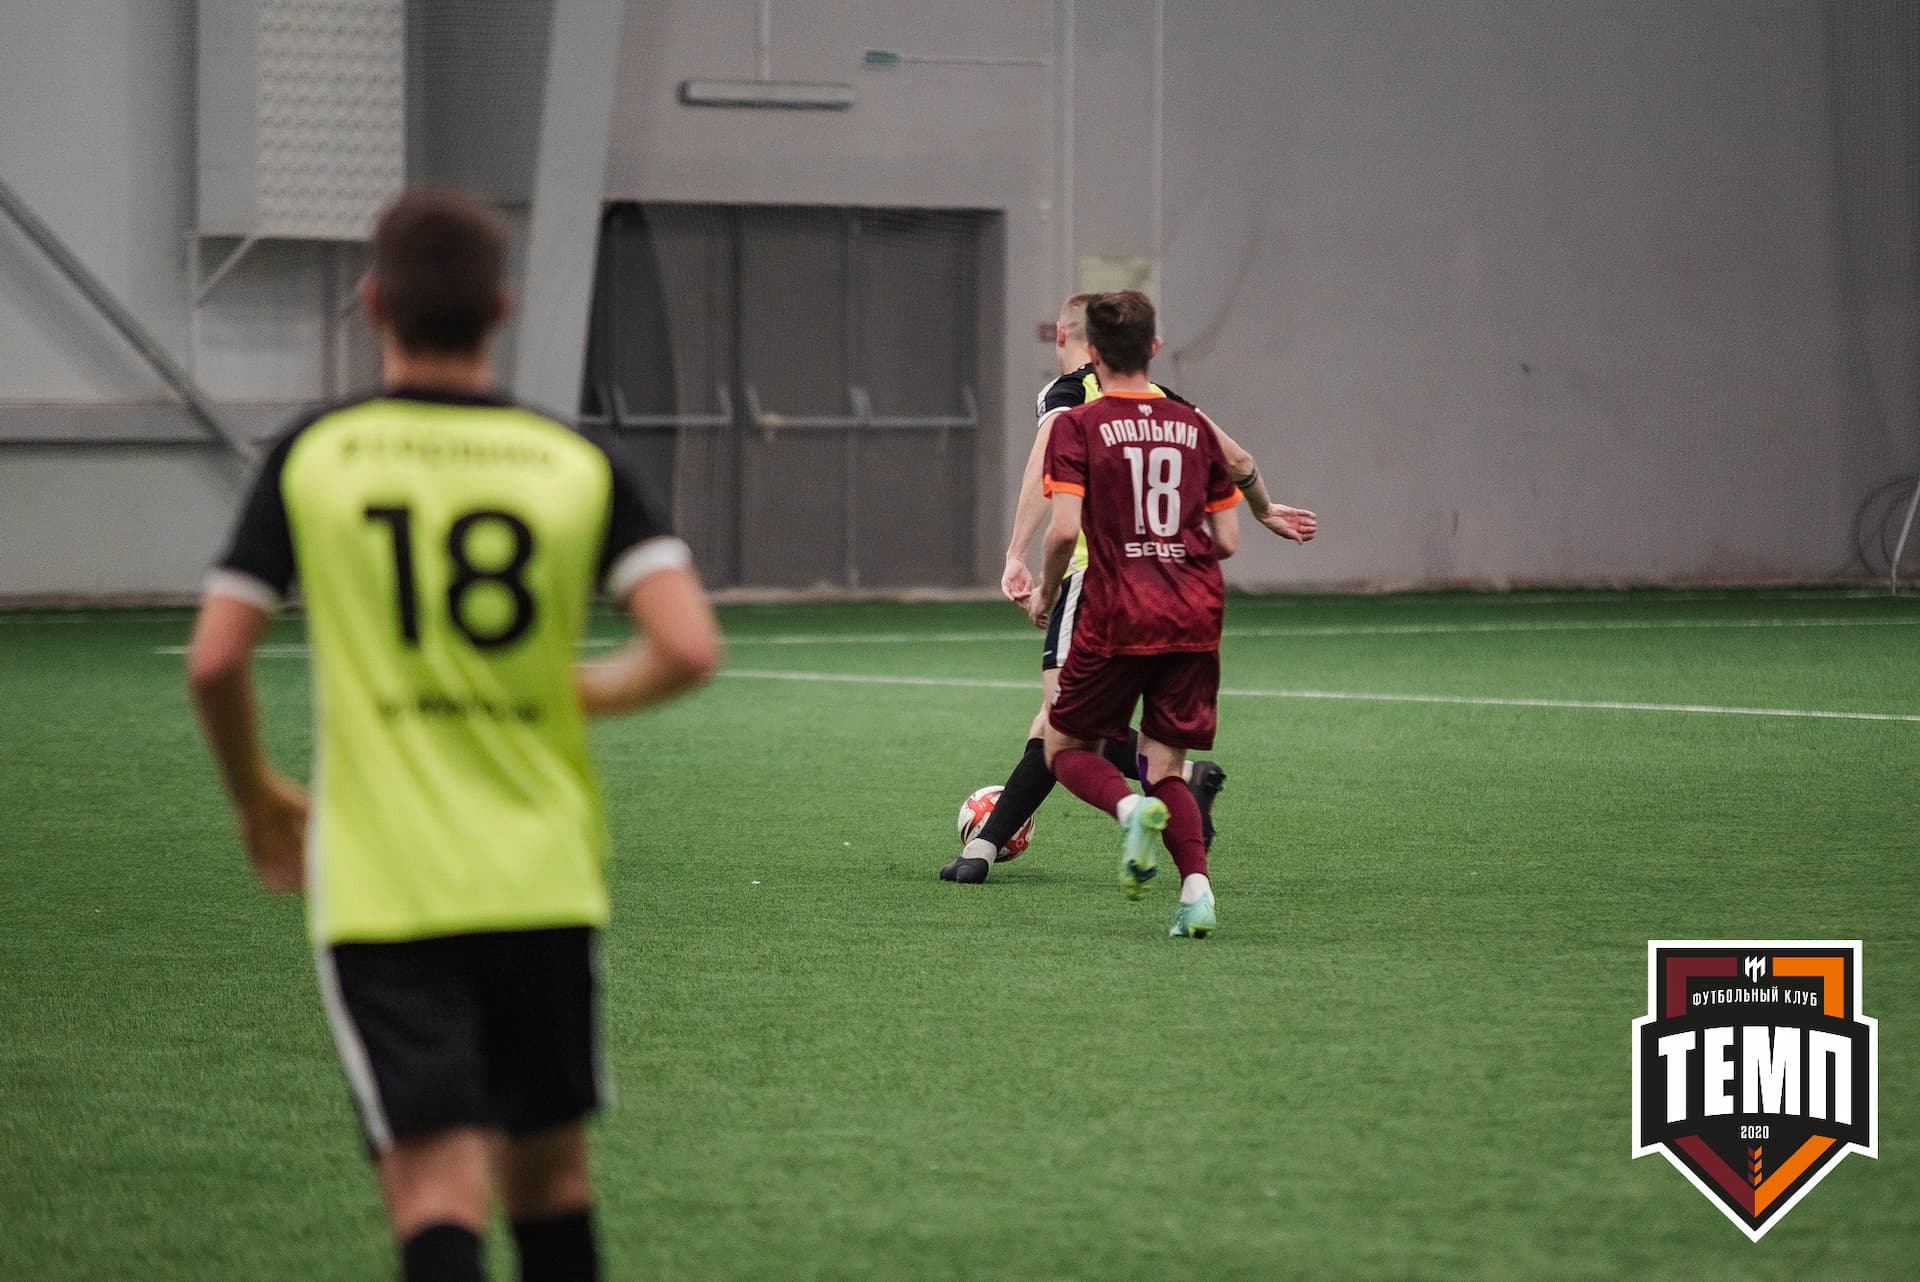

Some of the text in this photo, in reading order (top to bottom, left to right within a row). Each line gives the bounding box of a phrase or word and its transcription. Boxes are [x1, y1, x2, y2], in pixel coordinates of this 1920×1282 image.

[1099, 419, 1198, 449] АПАЛЬКИН
[1123, 446, 1182, 537] 18
[363, 505, 535, 650] 18
